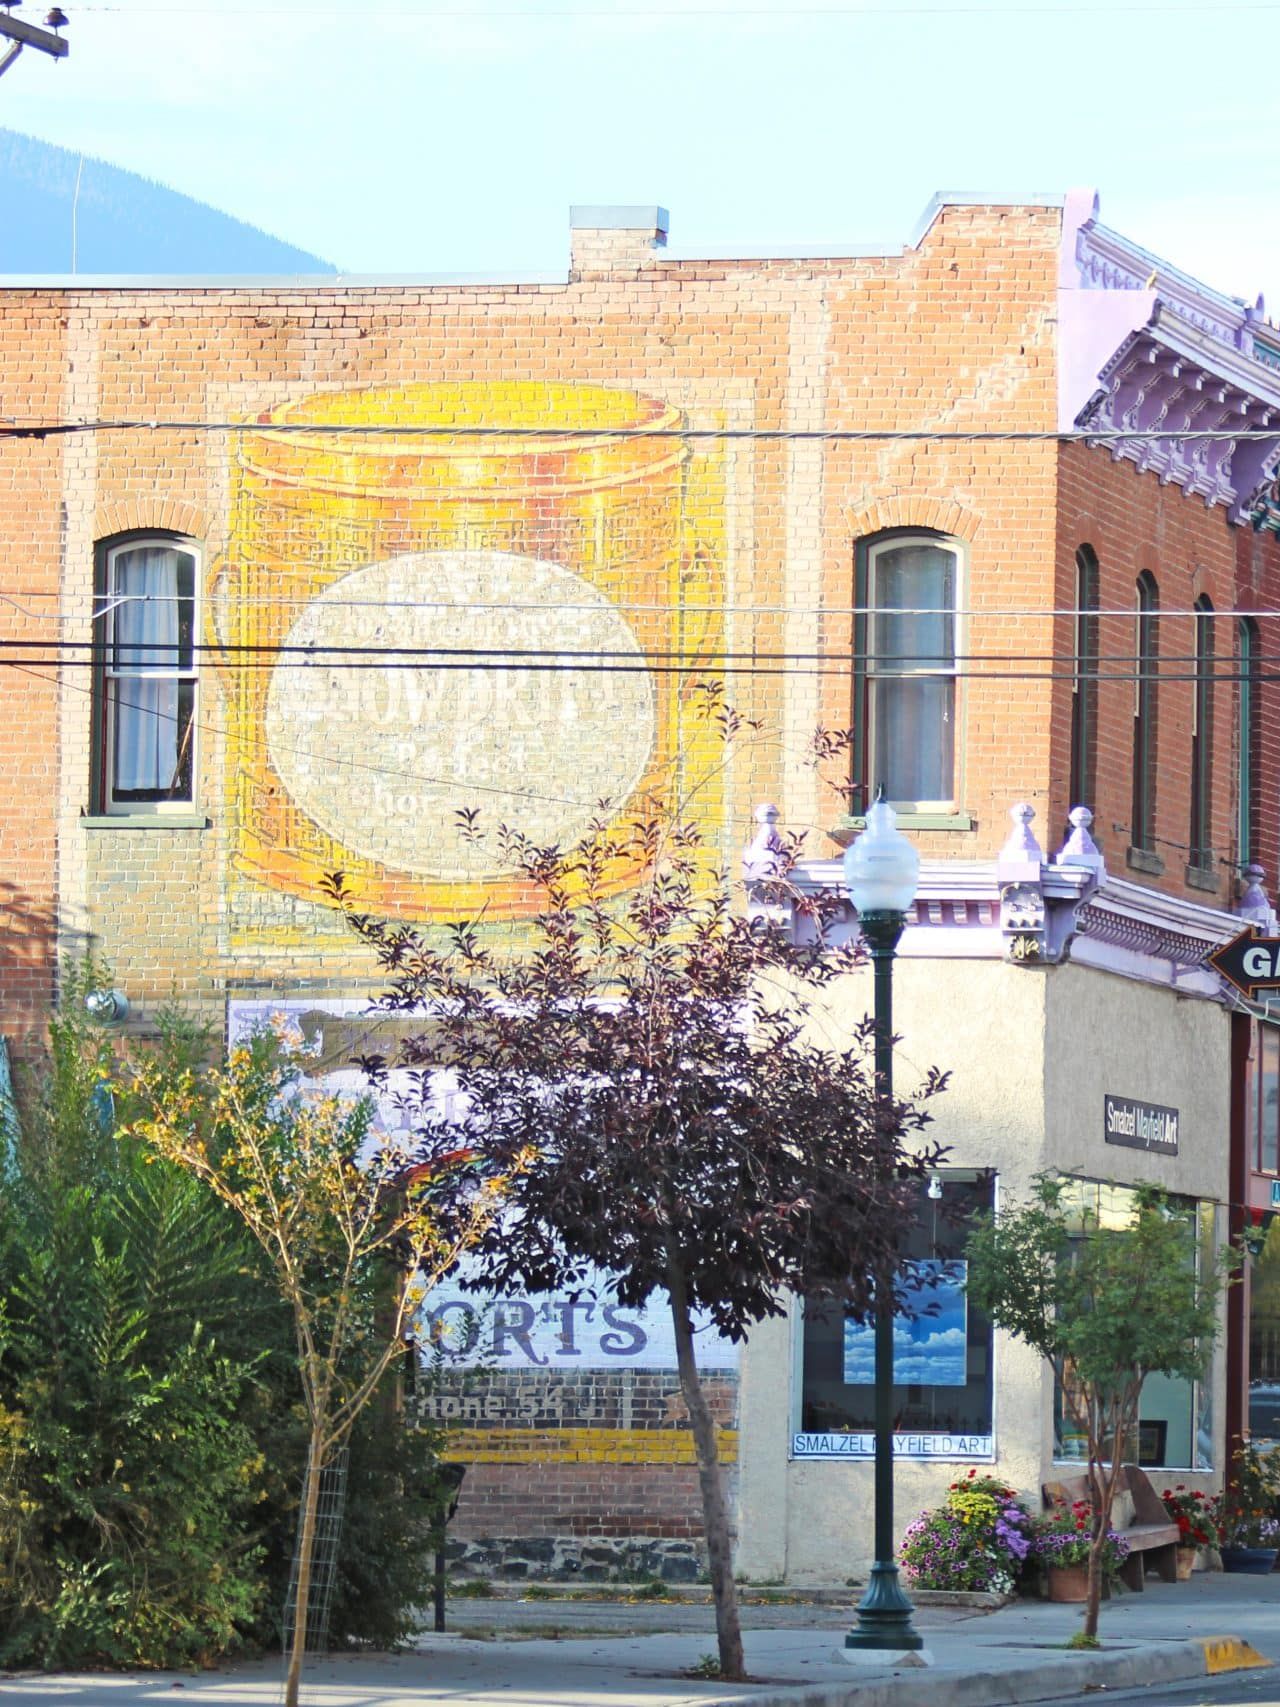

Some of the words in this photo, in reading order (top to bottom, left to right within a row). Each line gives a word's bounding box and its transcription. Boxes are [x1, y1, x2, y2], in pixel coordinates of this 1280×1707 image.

[1107, 1101, 1136, 1136] Smalzel
[1136, 1107, 1165, 1147] Mayfield
[1164, 1113, 1178, 1145] Art
[795, 1435, 869, 1452] SMALZEL
[872, 1436, 952, 1453] YFIELD
[957, 1437, 990, 1453] ART
